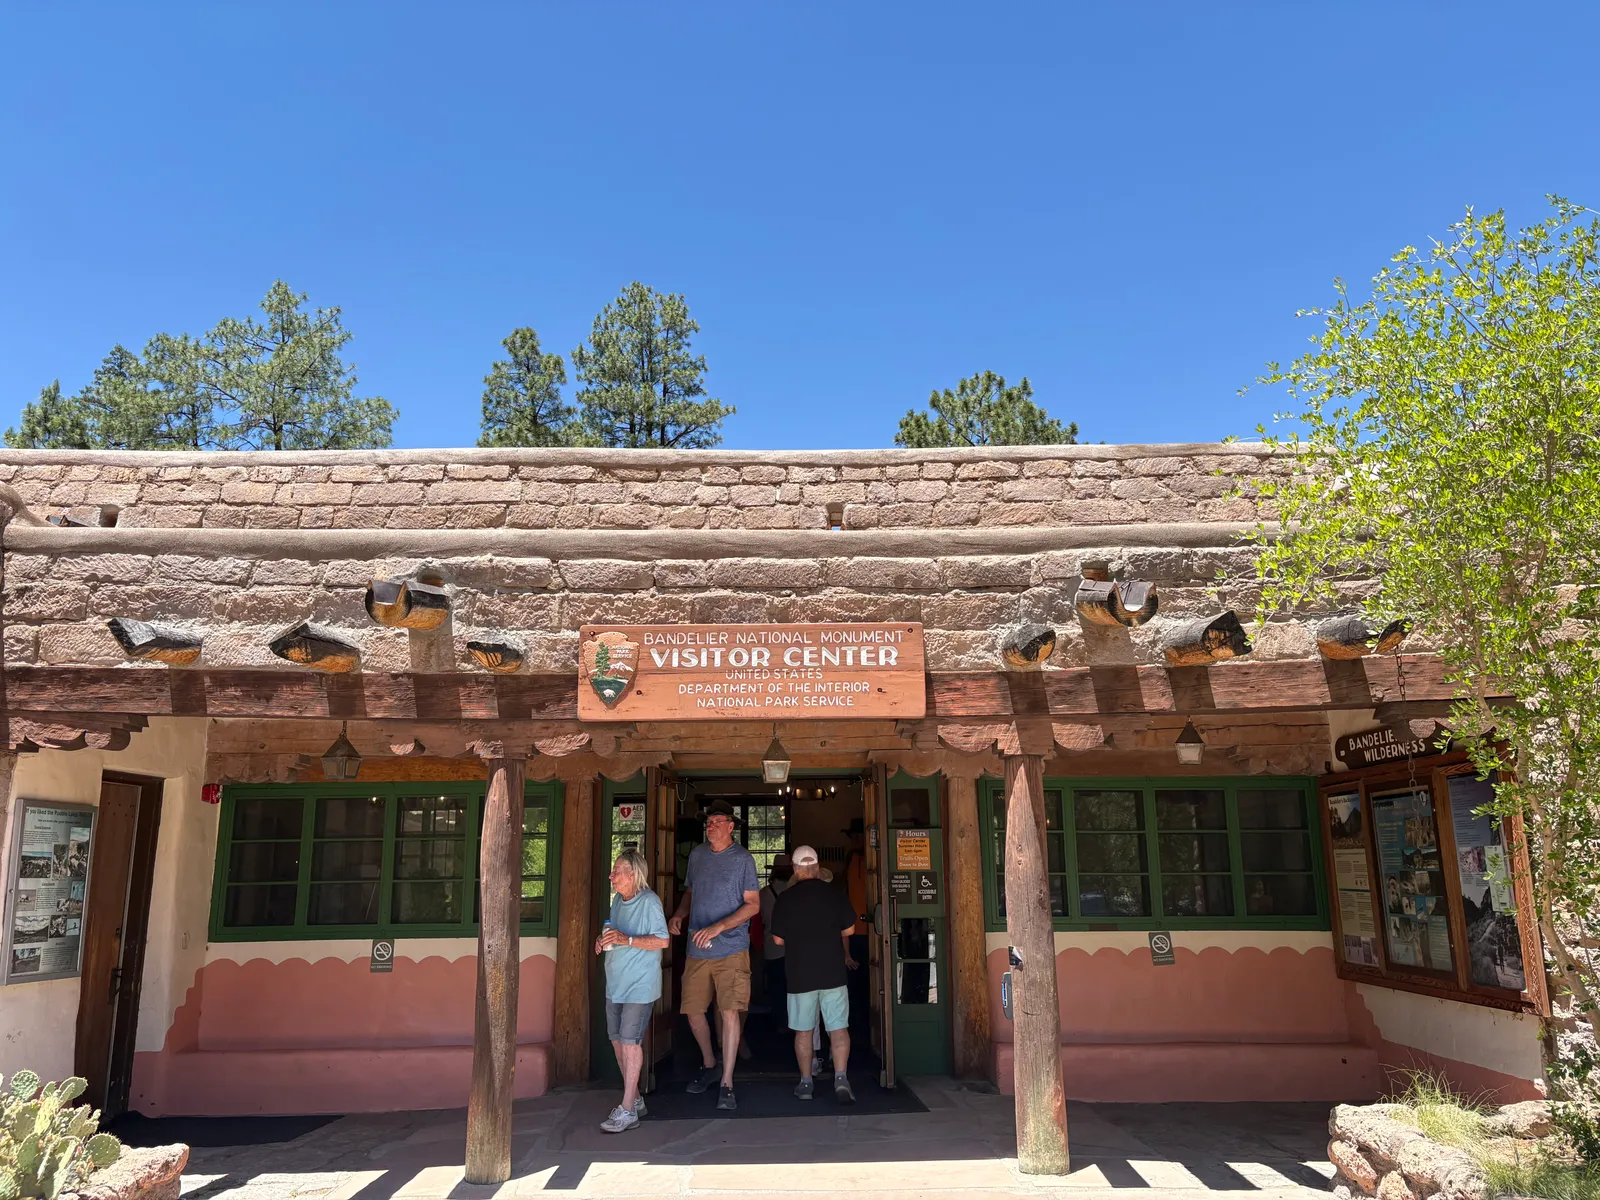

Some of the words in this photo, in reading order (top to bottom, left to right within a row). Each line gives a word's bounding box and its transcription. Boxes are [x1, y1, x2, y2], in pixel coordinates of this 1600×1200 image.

[643, 632, 729, 646] BANDELIER
[736, 631, 812, 645] NATIONAL
[820, 630, 904, 644] MONUMENT
[649, 647, 772, 668] VISITOR
[783, 646, 899, 667] CENTER
[725, 669, 770, 681] UNITED
[774, 668, 823, 680] STATES
[678, 683, 764, 695] DEPARTMENT
[767, 683, 783, 694] OF
[787, 682, 811, 693] THE
[814, 681, 871, 693] INTERIOR
[696, 697, 762, 709] NATIONAL
[765, 696, 799, 708] PARK
[803, 695, 855, 707] SERVICE
[1348, 729, 1398, 751] BANDELIE
[1363, 738, 1426, 763] WILDERNESS
